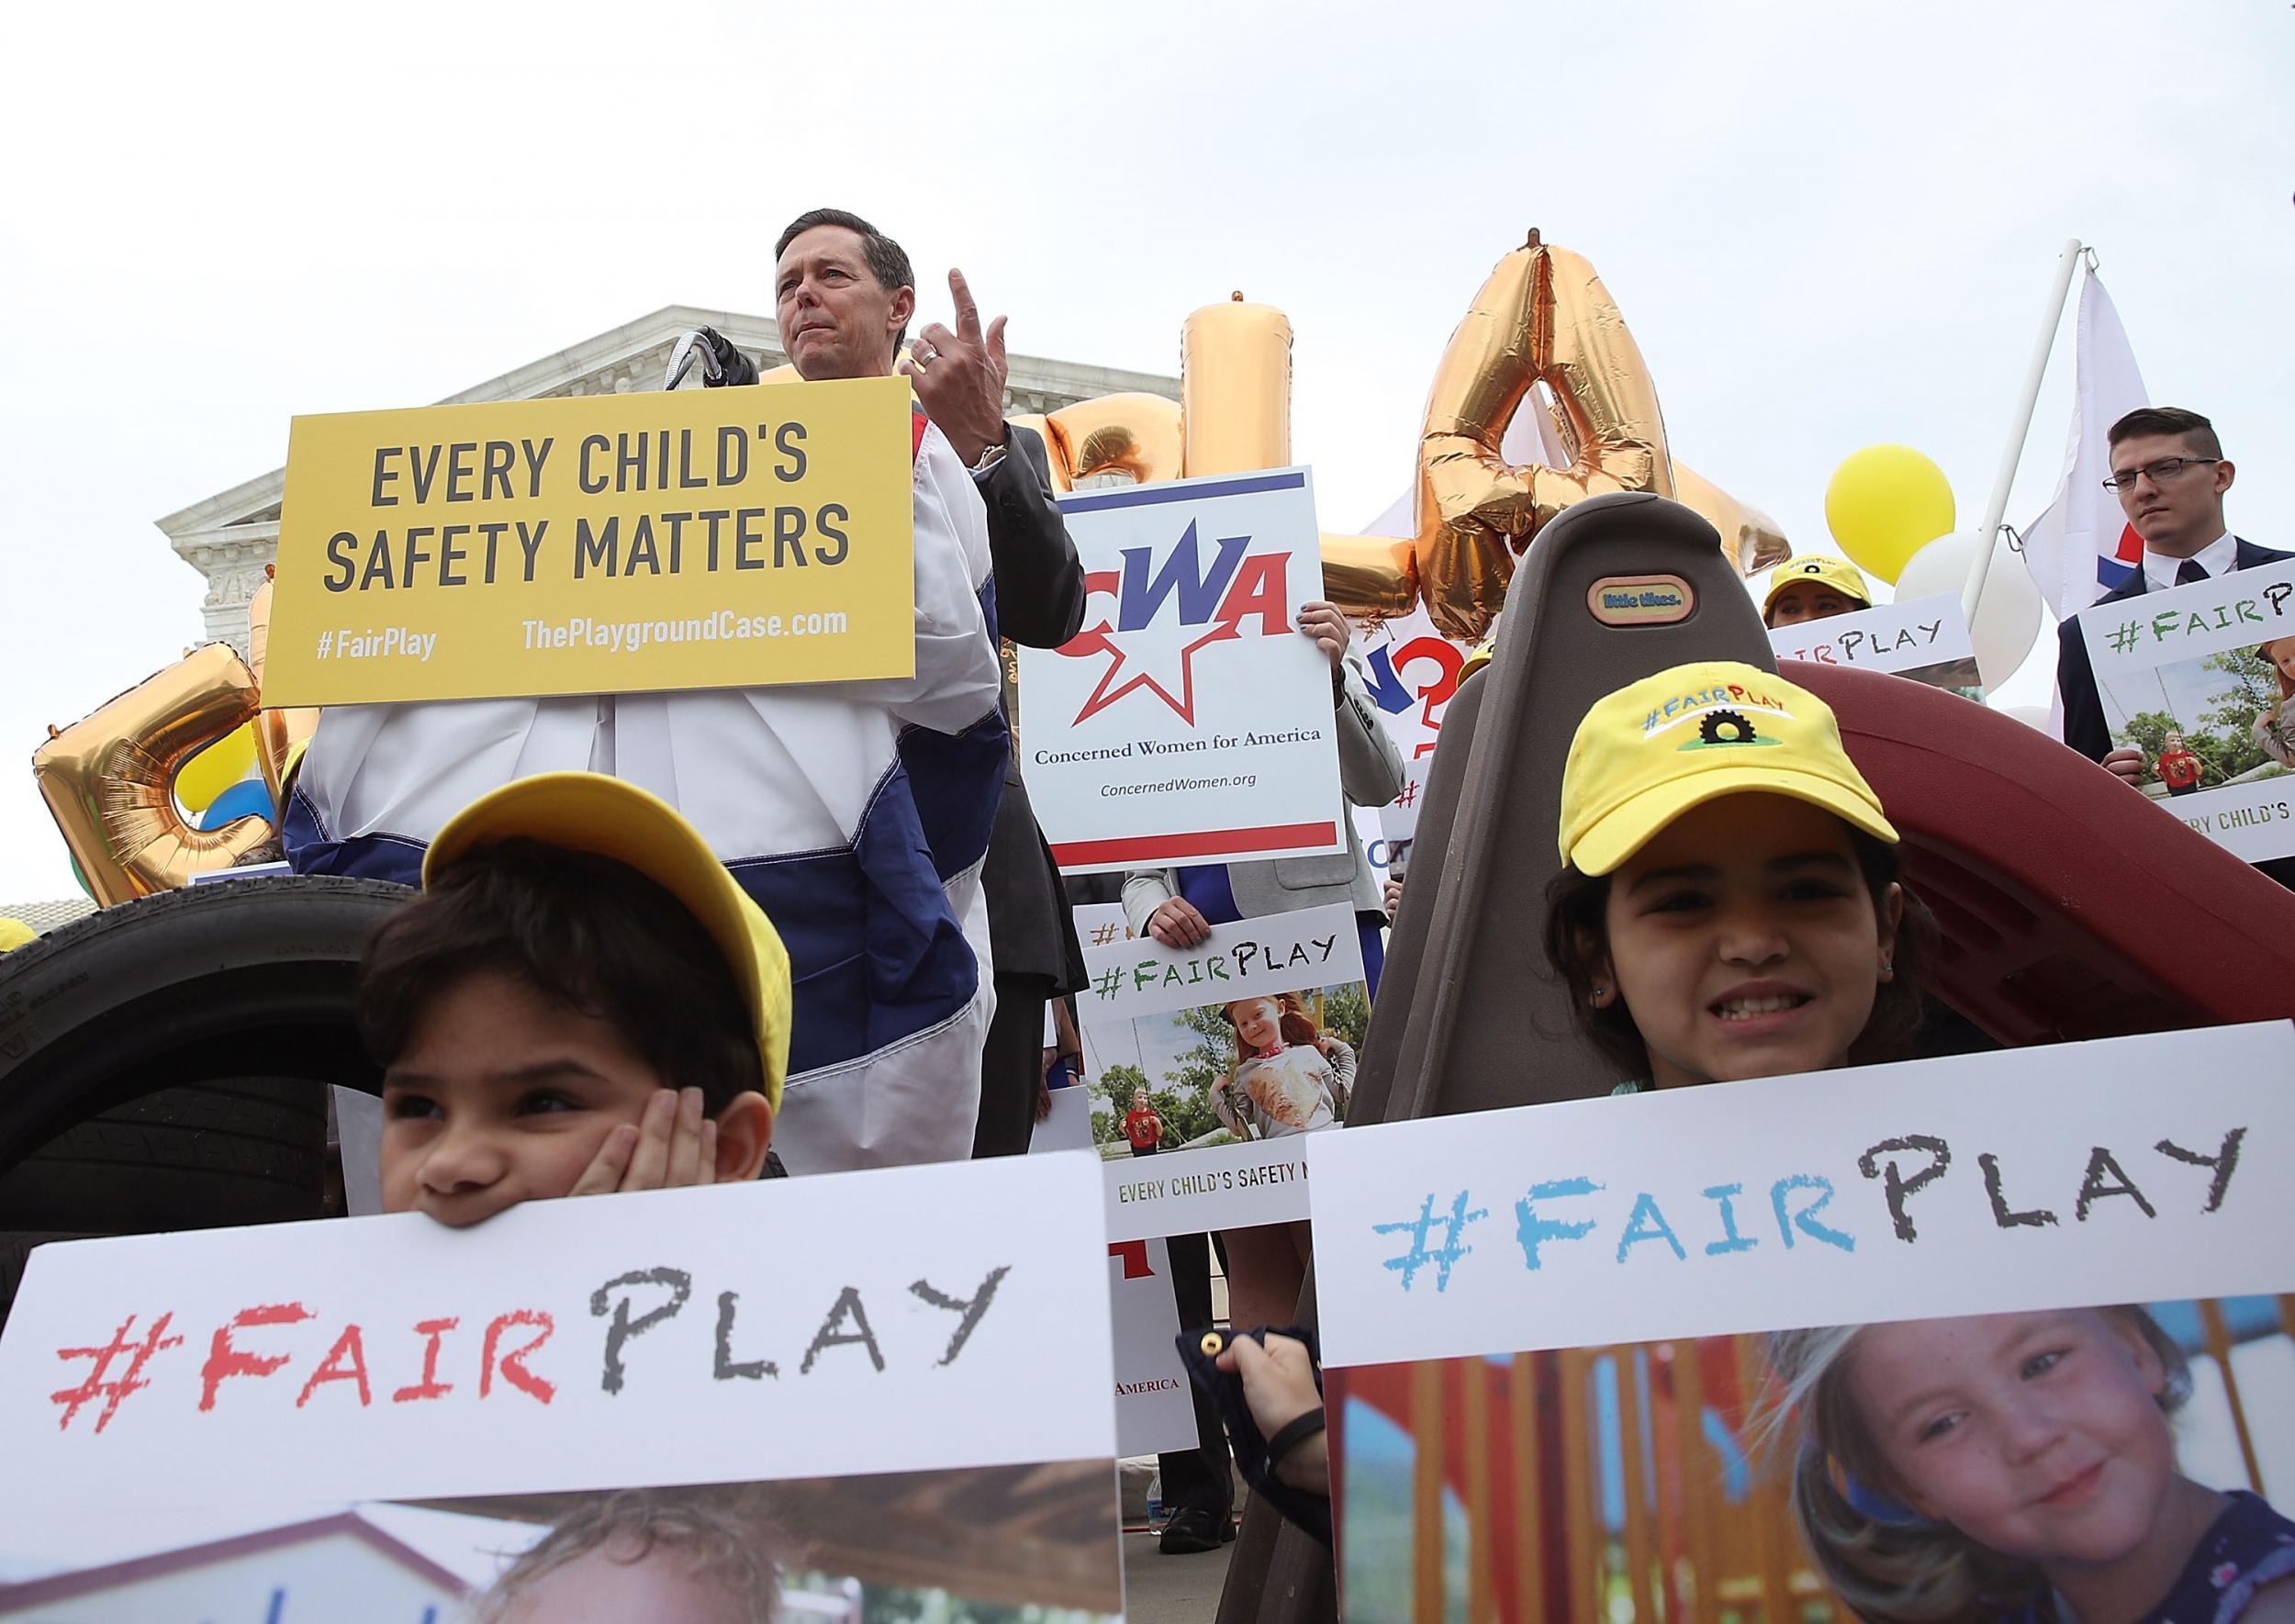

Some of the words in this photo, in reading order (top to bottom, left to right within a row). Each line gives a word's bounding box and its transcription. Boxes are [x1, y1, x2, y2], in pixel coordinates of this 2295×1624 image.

[372, 437, 554, 507] EVERY
[578, 421, 808, 495] CHILD'S
[323, 521, 549, 592] SAFETY
[573, 503, 849, 579] MATTERS
[1052, 517, 1294, 657] CWA
[1604, 593, 1639, 609] little
[316, 628, 436, 662] #FairPlay
[522, 610, 847, 652] ThePlaygroundCase.com
[1642, 684, 1784, 732] #FAIRPLAY
[1035, 744, 1133, 765] Concerned
[1137, 740, 1207, 756] Women
[1212, 734, 1238, 750] for
[1244, 727, 1322, 746] America
[1101, 773, 1257, 798] ConcernedWomen.org
[2182, 815, 2211, 834] RY
[2218, 801, 2290, 830] CHILD'S
[1092, 933, 1337, 1002] #FAIRPLAY
[1119, 1180, 1165, 1204] EVERY
[1171, 1170, 1233, 1196] CHILD'S
[1237, 1162, 1295, 1188] SAFETY
[1371, 1126, 2248, 1294] #FAIRPLAY
[50, 1264, 1013, 1435] #FAIRPLAY
[1114, 1378, 1180, 1395] AMERICA
